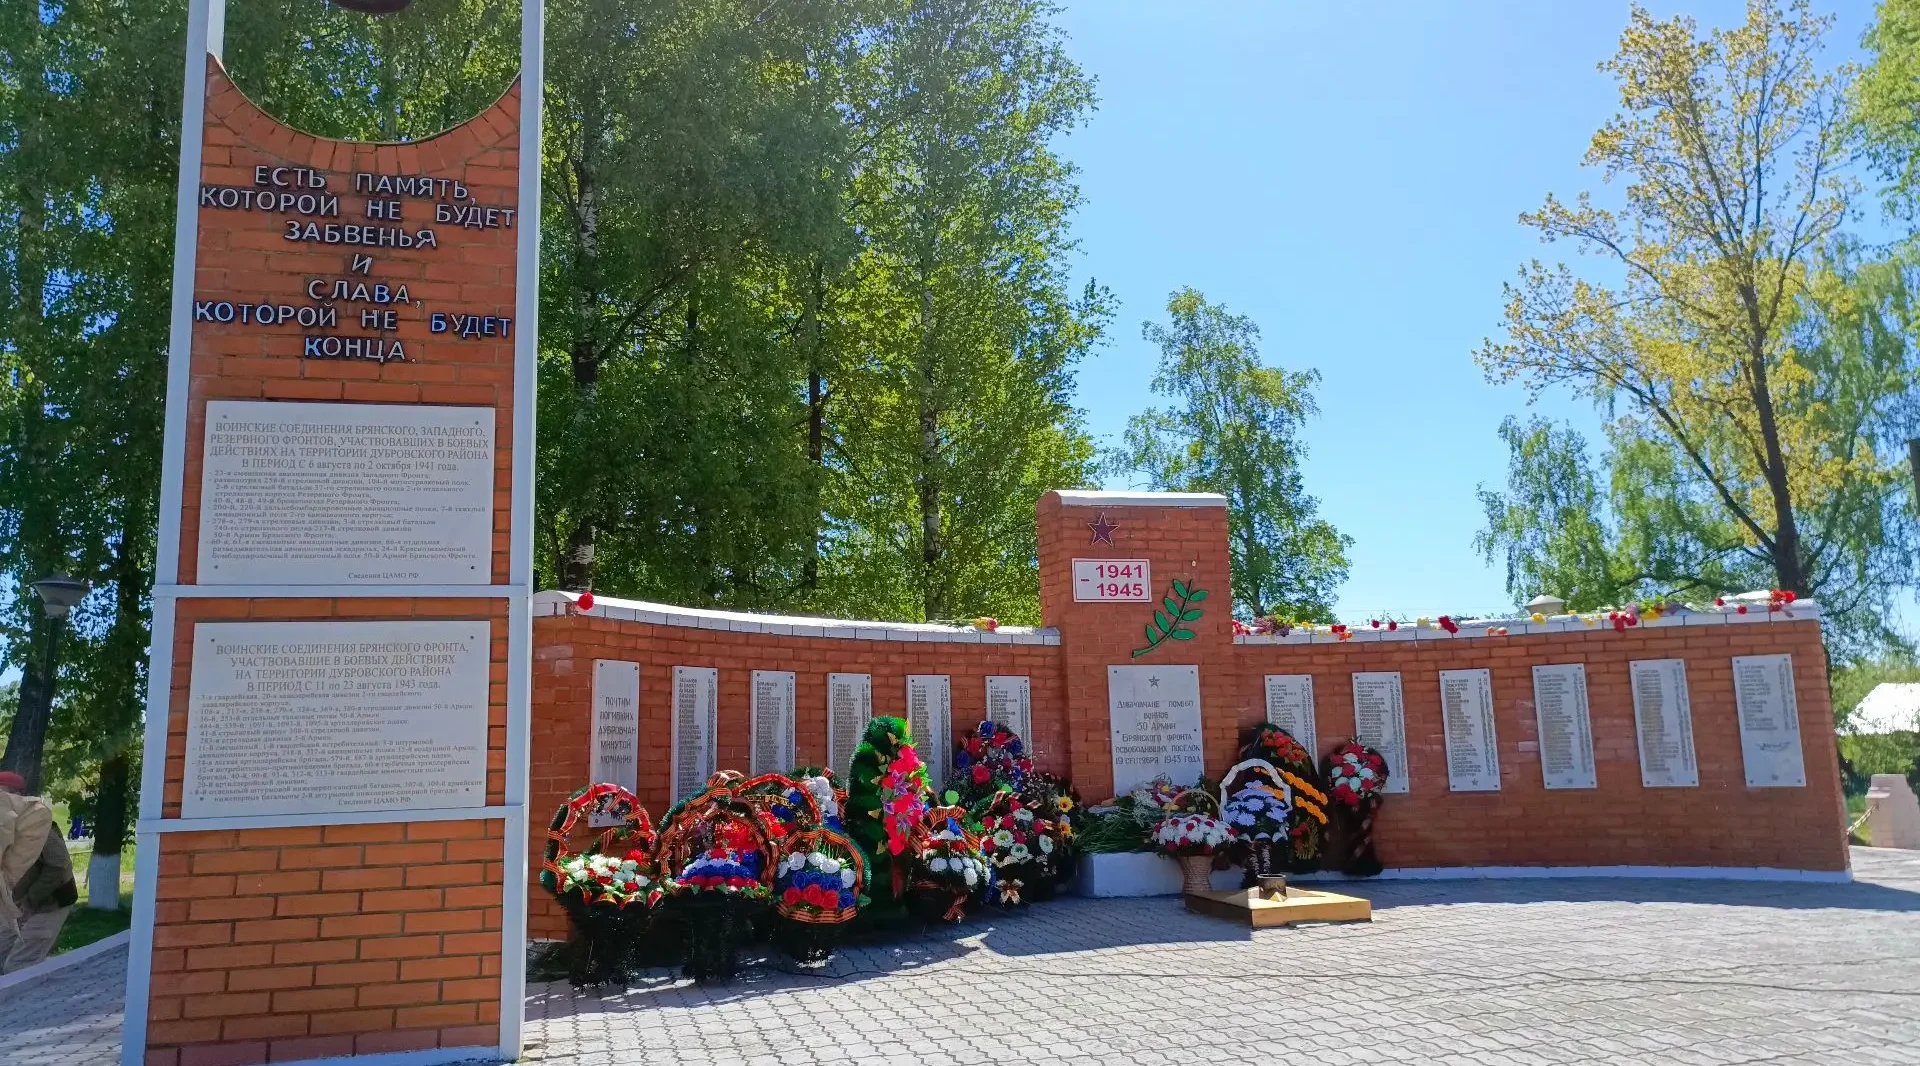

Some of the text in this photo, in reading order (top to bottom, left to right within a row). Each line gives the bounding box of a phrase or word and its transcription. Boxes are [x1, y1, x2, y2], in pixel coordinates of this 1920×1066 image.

[255, 165, 477, 206] ЕСТЬ ПАМЯТЬ,
[201, 188, 515, 228] КОТОРОЙ НЕ БУДЕТ
[284, 220, 437, 249] ЗАБВЕНЬЯ
[351, 253, 373, 275] И
[308, 279, 422, 309] СЛАВА,
[196, 301, 511, 339] КОТОРОЙ НЕ БУДЕТ
[304, 337, 417, 363] КОНЦА.
[215, 423, 484, 437] ВОИНСКИЕ СОЕДИНЕНИЯ БРЯНСКОГО, ЗАПАДНОГО,
[211, 434, 489, 449] РЕЗЕРВНОГО ФРОНТОВ, УЧАСТВОВАВШИХ В БОЕВЫХ
[210, 445, 488, 460] ДЕЙСТВИЯХ НА ТЕРРИТОРИИ ДУБРОВСКОГО РАЙОНА
[242, 458, 248, 467] В
[252, 459, 295, 469] ПЕРИОД
[299, 460, 306, 469] С
[317, 462, 351, 472] августа
[368, 461, 374, 470] 2
[376, 463, 411, 472] октября
[414, 461, 434, 471] 1941
[437, 464, 459, 472] года.
[1096, 564, 1143, 578] 1941
[1096, 584, 1144, 597] 1945
[216, 642, 469, 654] ВОИНСКИЕ СОЕДИНЕНИЯ БРЯНСКОГО ФРОНТА,
[231, 653, 456, 667] УЧАСТВОВАВШИЕ В БОЕВЫХ ДЕЙСТВИЯХ
[235, 665, 452, 679] НА ТЕРРИТОРИИ ДУБРОВСКОГО РАЙОНА
[247, 682, 254, 692] В
[257, 681, 302, 692] ПЕРИОД
[305, 681, 312, 690] С
[316, 681, 324, 690] 11
[344, 681, 353, 690] 23
[356, 682, 392, 691] августа
[395, 680, 416, 689] 1943
[419, 681, 440, 689] года.
